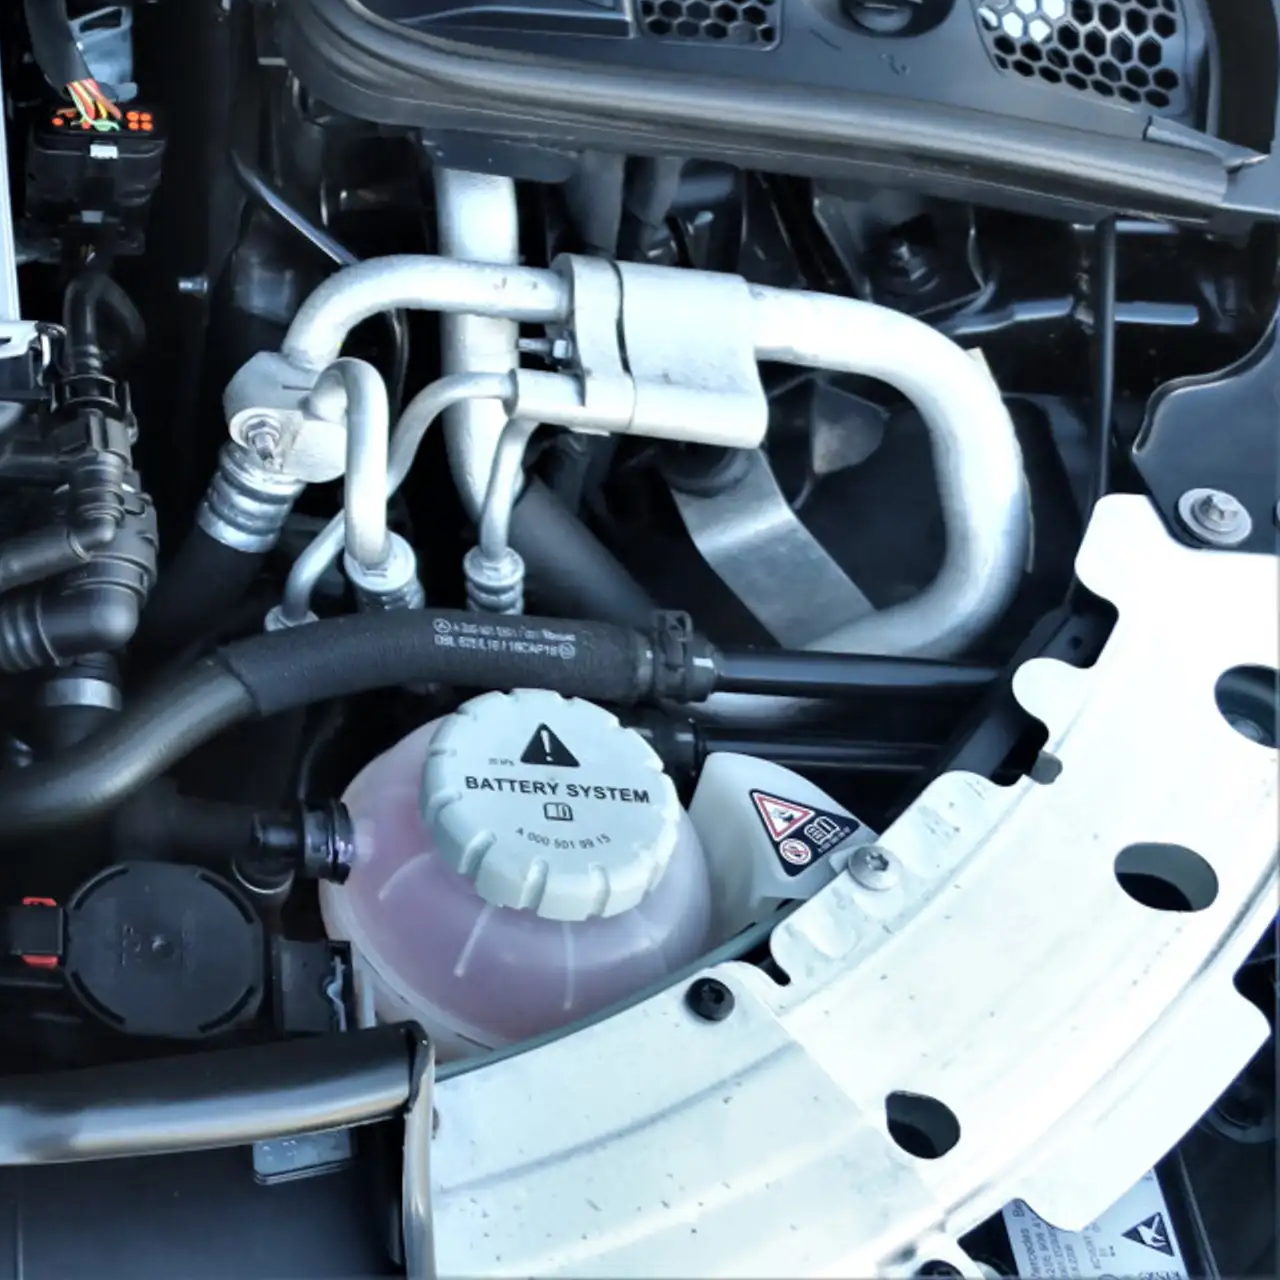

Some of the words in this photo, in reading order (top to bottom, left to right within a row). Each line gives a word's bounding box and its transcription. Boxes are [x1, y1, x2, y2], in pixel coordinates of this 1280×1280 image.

[465, 776, 560, 796] BATTERY
[566, 783, 650, 804] SYSTEM
[527, 831, 550, 847] 000
